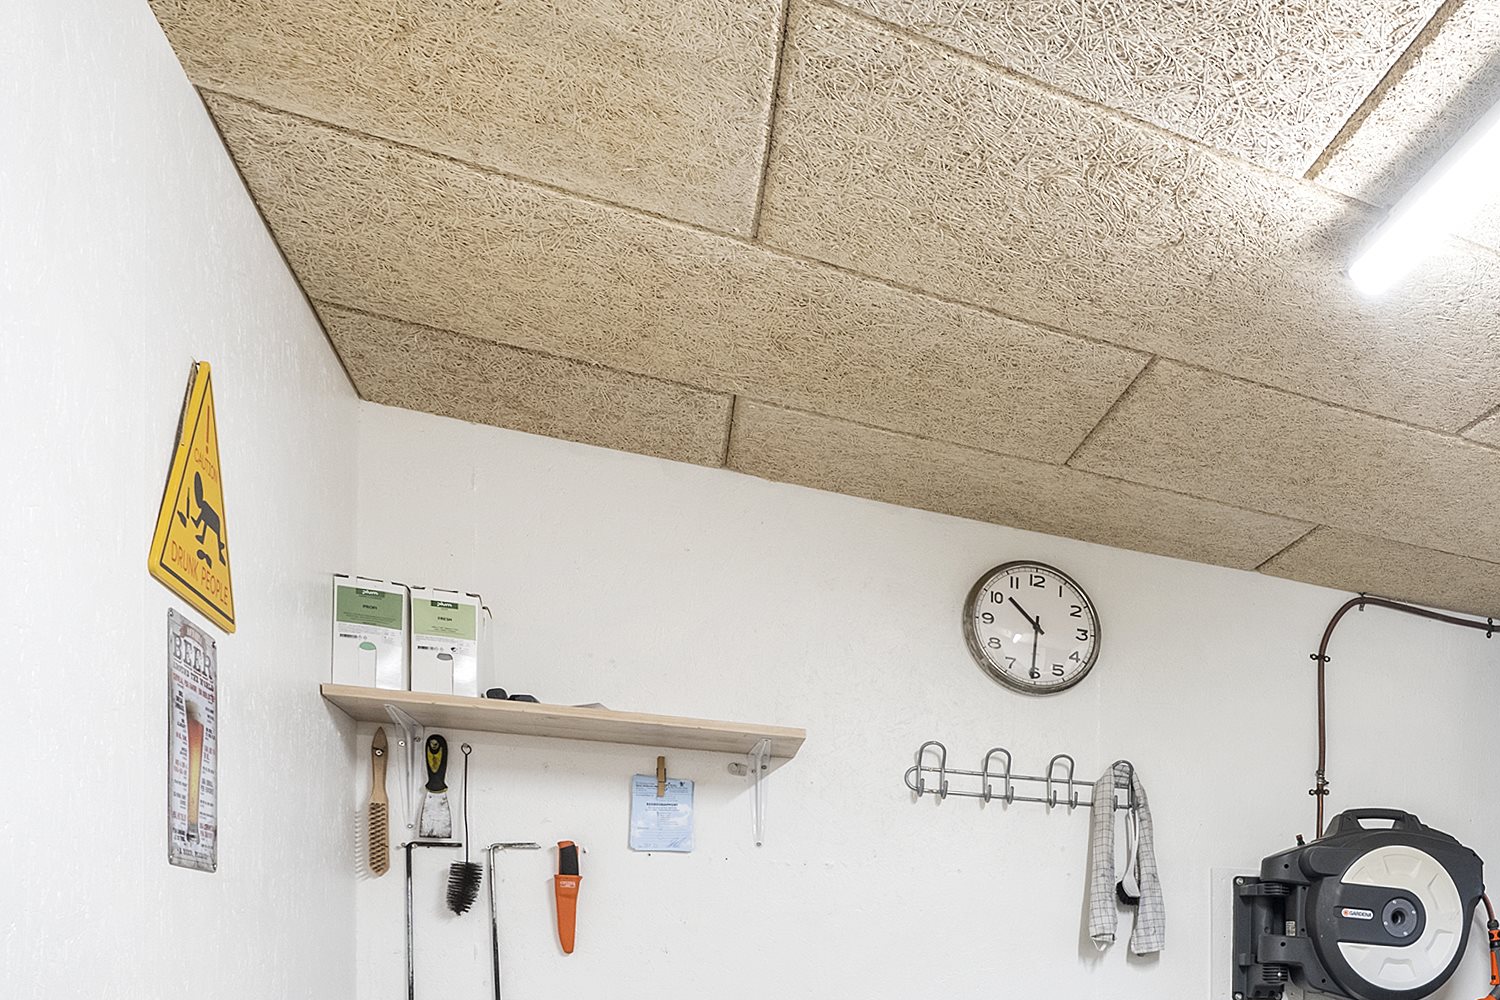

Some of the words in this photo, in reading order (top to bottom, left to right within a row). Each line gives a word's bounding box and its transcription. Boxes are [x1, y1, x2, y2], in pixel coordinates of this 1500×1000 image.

[171, 540, 198, 581] DRUNK
[201, 566, 228, 606] PEOPLE
[1010, 576, 1019, 589] 11
[1029, 574, 1046, 588] 12
[990, 591, 1004, 604] 10
[1059, 585, 1063, 598] 1
[1069, 605, 1082, 618] 2
[981, 612, 995, 625] 9
[1075, 628, 1089, 641] 3
[987, 637, 1002, 649] 8
[173, 632, 213, 680] BEER
[1005, 656, 1016, 669] 7
[1068, 651, 1081, 663] 4
[1029, 667, 1041, 680] 6
[1051, 664, 1064, 677] 5
